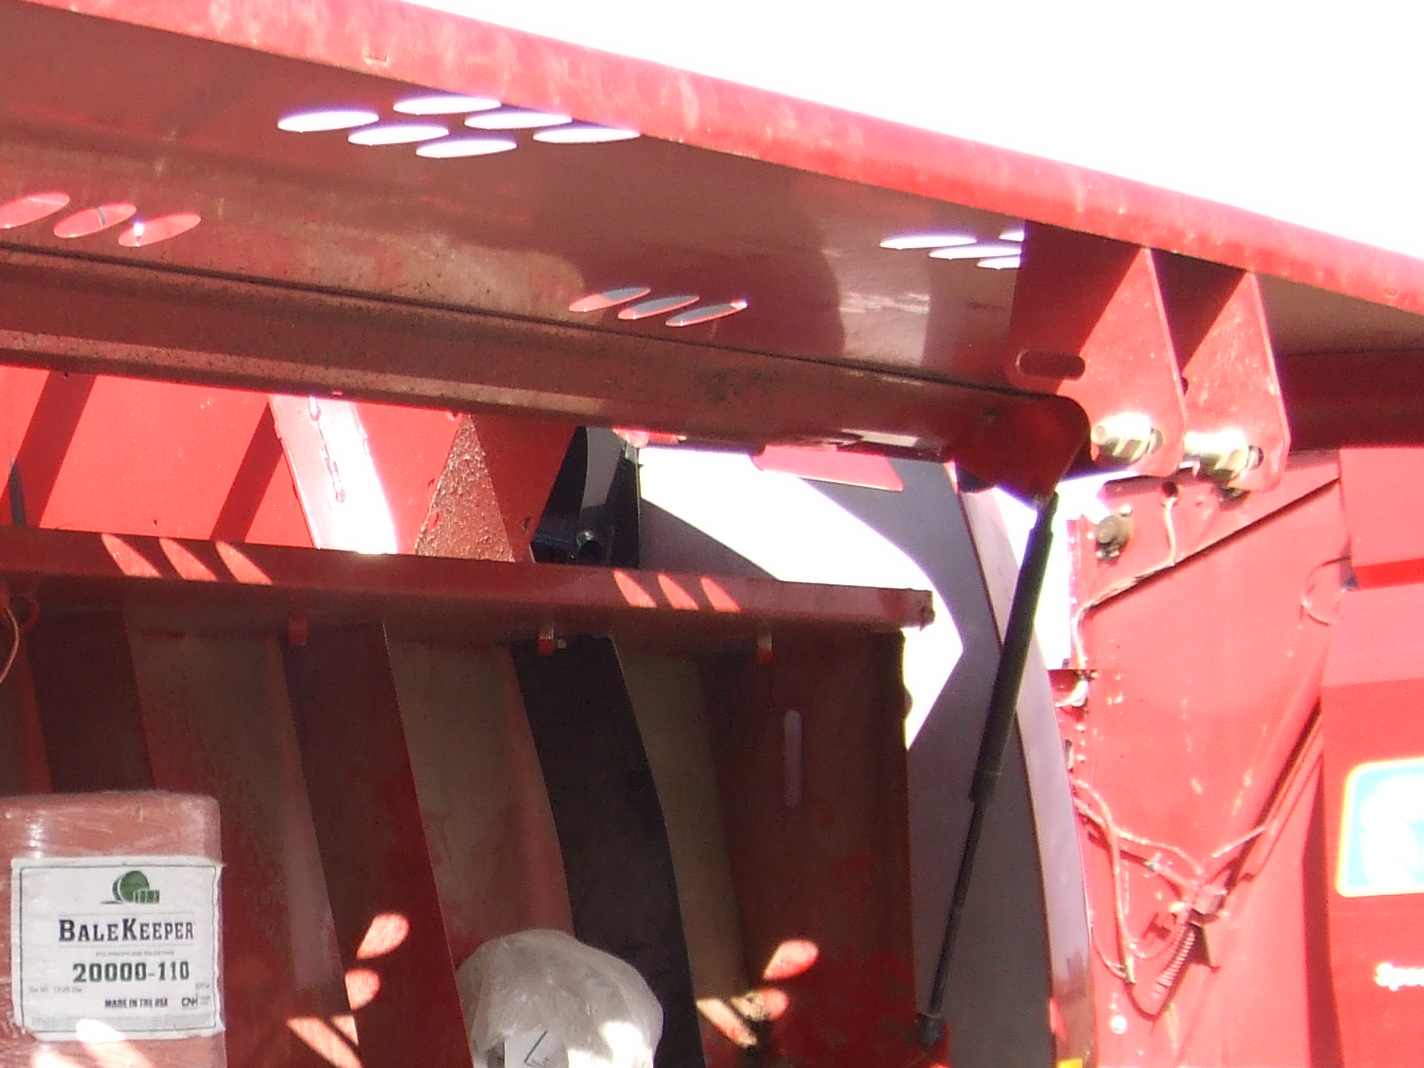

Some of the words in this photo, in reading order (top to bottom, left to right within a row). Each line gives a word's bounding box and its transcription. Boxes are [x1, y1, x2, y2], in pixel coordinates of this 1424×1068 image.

[72, 961, 189, 983] 20000-110
[104, 998, 127, 1009] MADE
[129, 998, 138, 1008] IN
[139, 998, 153, 1008] THE
[154, 998, 168, 1008] USA
